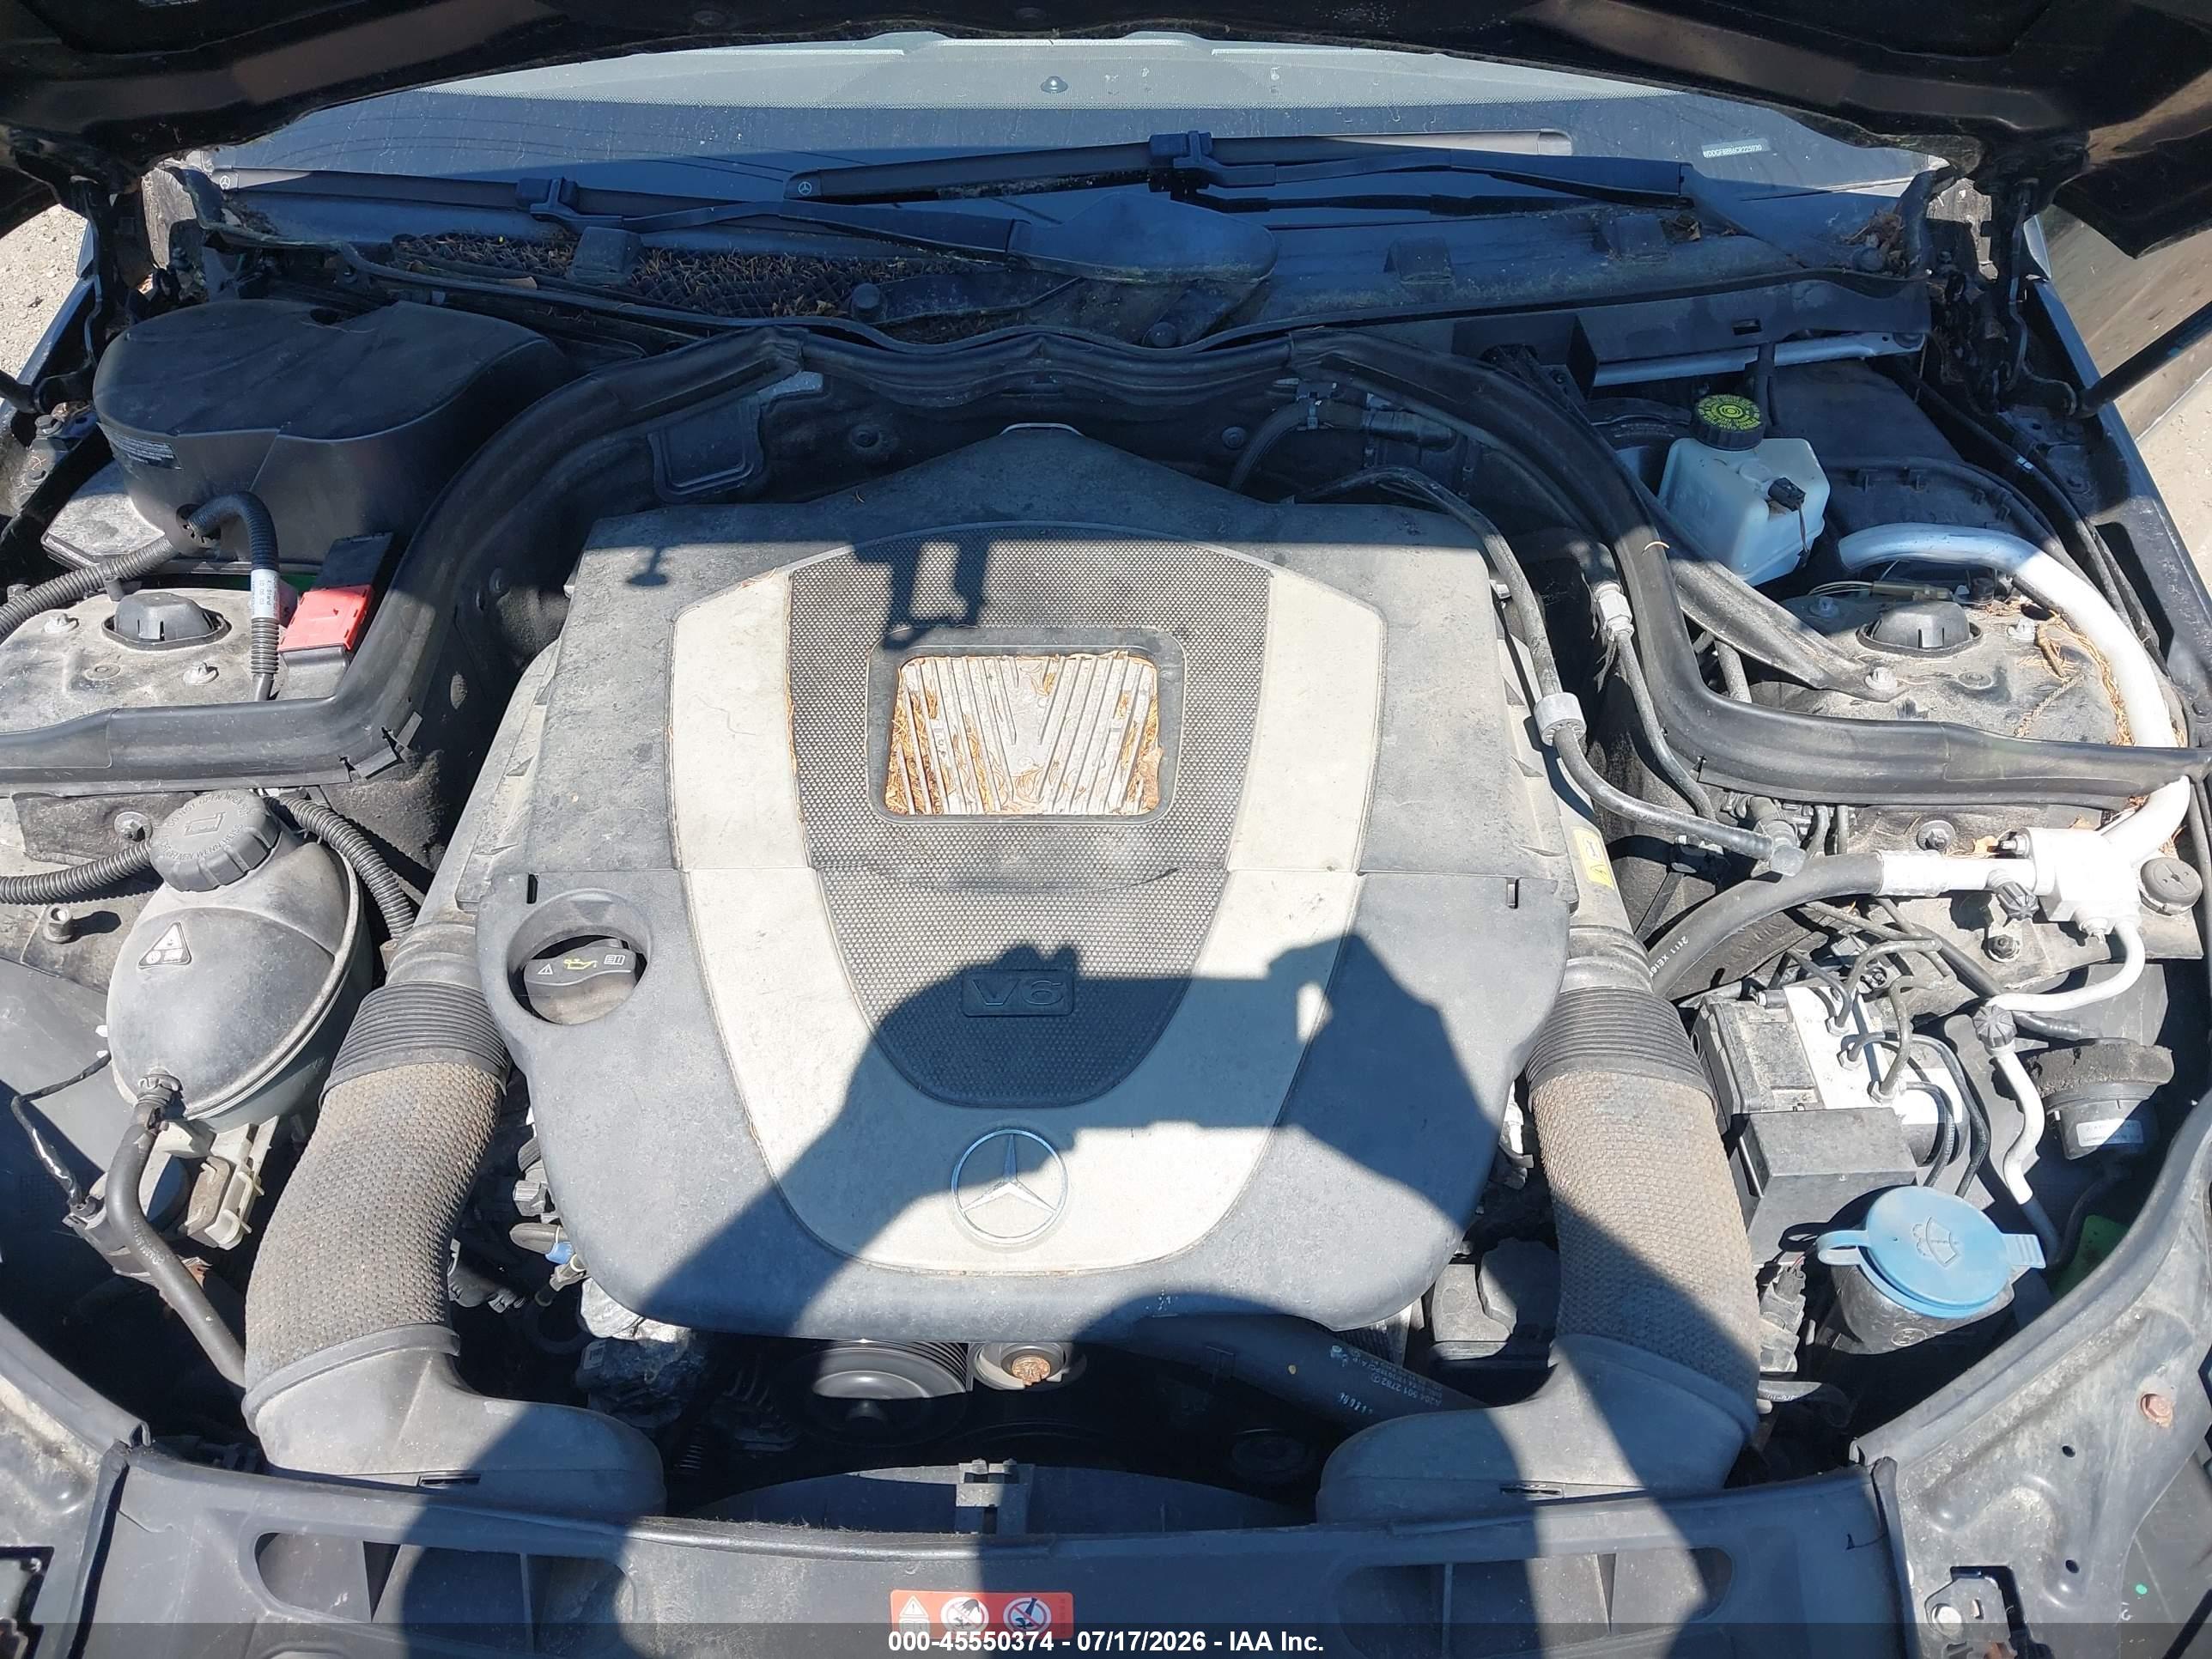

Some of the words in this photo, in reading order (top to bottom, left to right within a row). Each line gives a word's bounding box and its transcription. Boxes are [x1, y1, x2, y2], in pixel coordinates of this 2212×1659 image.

[1669, 935, 1689, 955] 2111
[971, 979, 1065, 1006] V6
[1381, 1376, 1402, 1392] 2782
